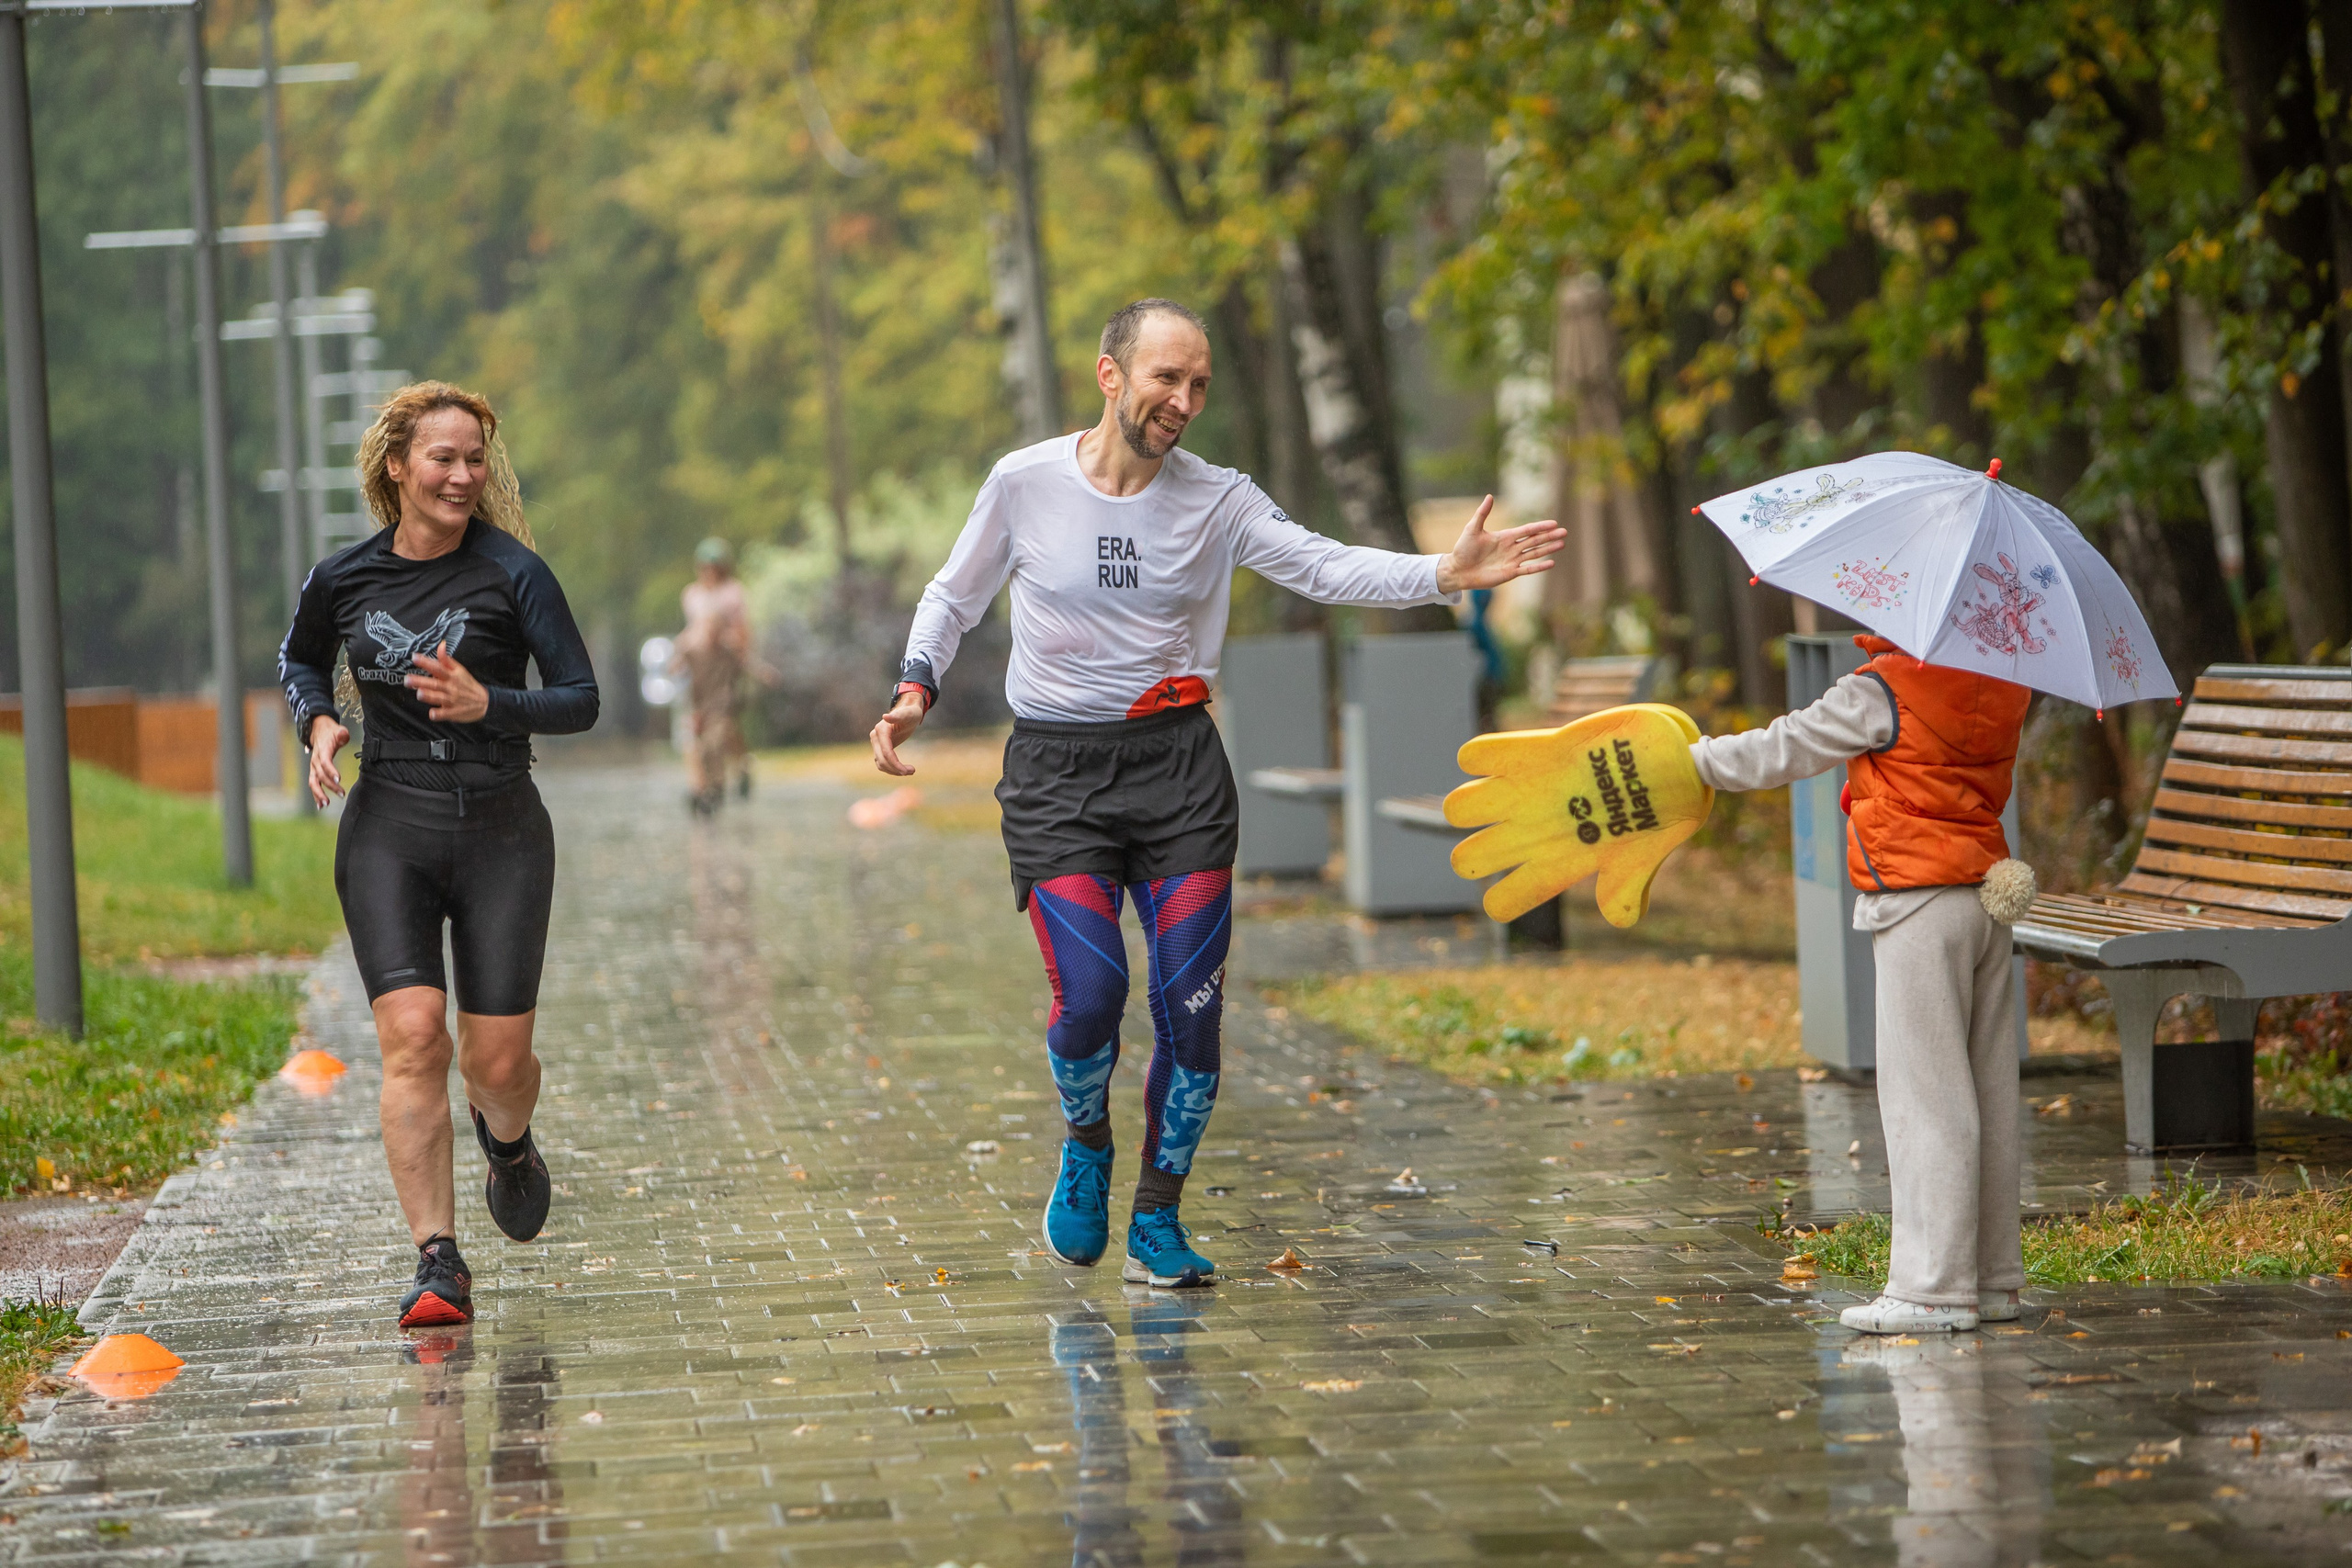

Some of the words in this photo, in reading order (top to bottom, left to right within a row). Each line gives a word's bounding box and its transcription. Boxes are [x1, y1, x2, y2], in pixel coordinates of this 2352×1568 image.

[1098, 536, 1141, 560] ERA.
[1098, 564, 1138, 588] RUN
[1588, 747, 1633, 837] Яндекс
[1612, 739, 1659, 830] Маркет
[1184, 982, 1214, 1014] МЫ
